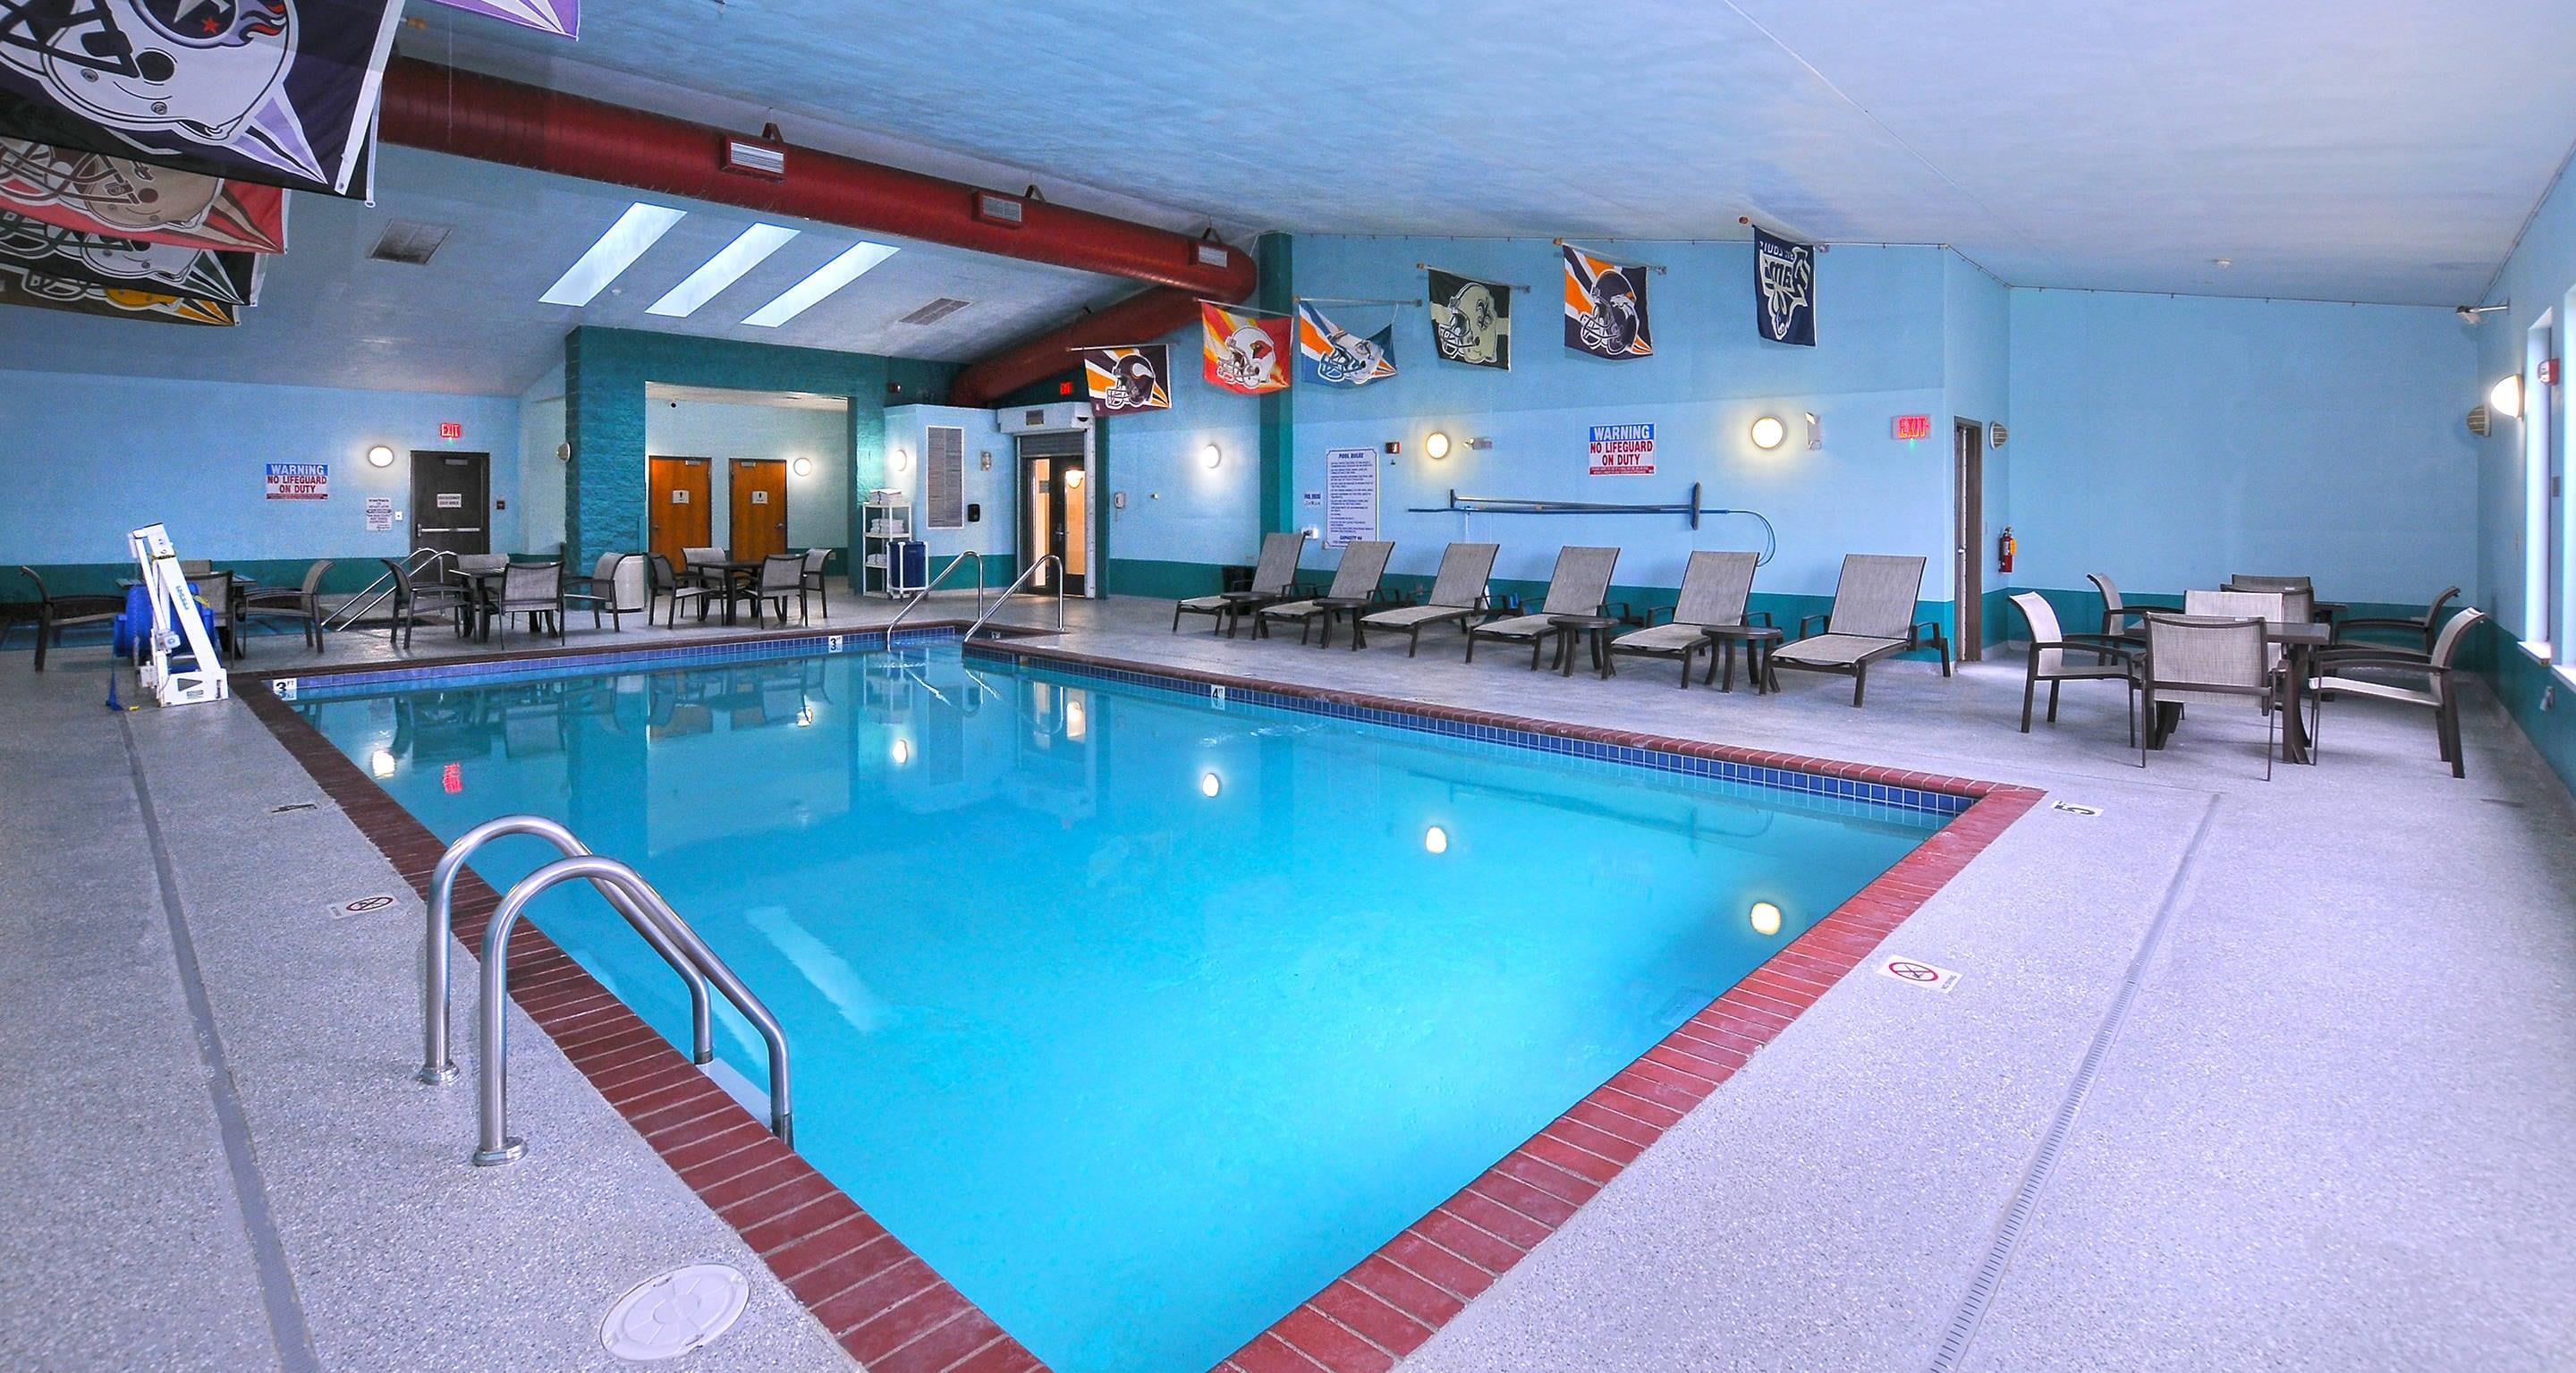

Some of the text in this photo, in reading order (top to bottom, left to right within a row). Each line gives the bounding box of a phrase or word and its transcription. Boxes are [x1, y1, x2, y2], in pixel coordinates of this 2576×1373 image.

[442, 423, 459, 436] EXIT
[1594, 425, 1649, 441] WARNING
[1898, 416, 1926, 438] EXIT
[1590, 440, 1653, 453] NO LIFEGUARD
[1602, 453, 1640, 466] ON DUTY
[271, 464, 324, 475] WARNING
[267, 475, 327, 484] NO LIFEGUARD
[279, 485, 316, 493] ON DUTY
[275, 682, 287, 691] 3
[1212, 688, 1219, 698] 4
